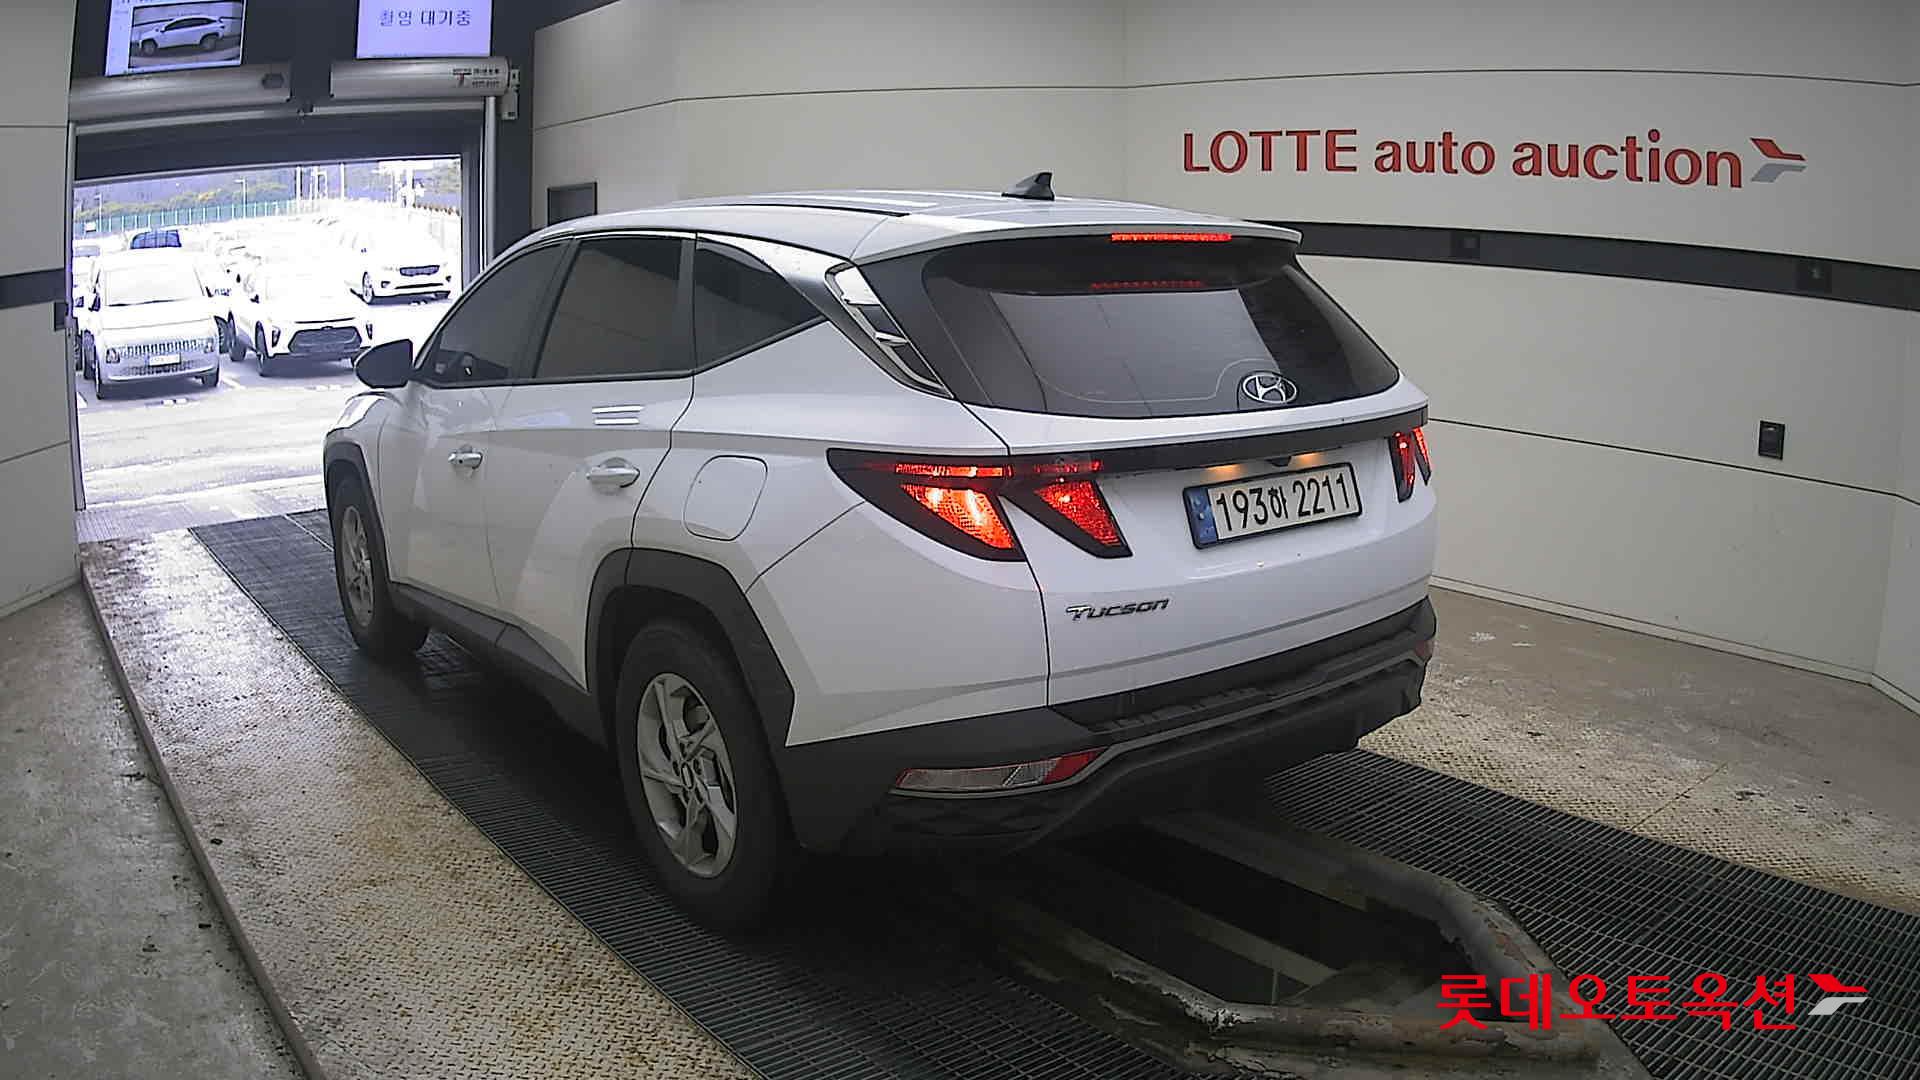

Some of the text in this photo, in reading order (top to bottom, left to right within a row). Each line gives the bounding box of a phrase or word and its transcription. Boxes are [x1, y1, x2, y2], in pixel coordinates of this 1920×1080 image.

[420, 9, 471, 26] 대기중
[1183, 128, 1743, 189] LOTTE auto auction
[1215, 472, 1351, 532] 193하 2211
